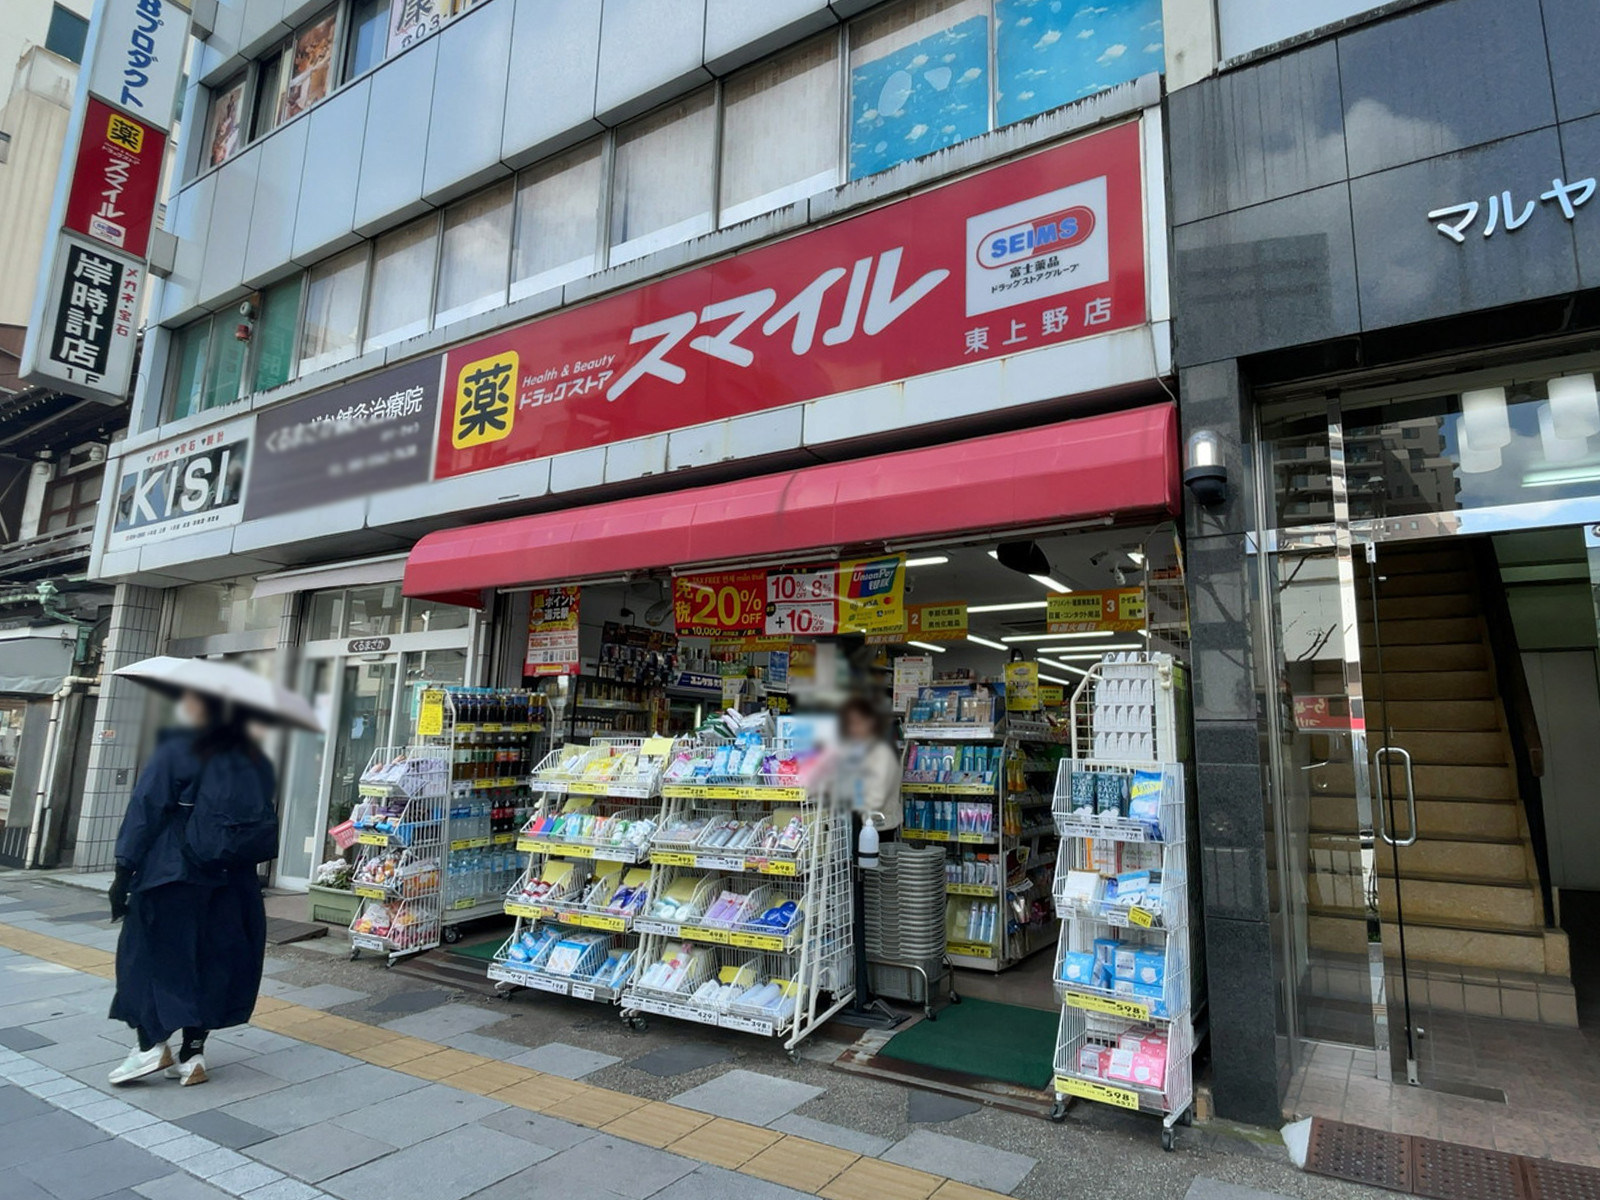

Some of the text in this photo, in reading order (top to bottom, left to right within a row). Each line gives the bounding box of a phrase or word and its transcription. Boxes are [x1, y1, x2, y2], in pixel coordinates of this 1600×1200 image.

[109, 117, 142, 150] 薬
[97, 158, 130, 218] スマイル
[991, 217, 1079, 259] SEIMS
[991, 263, 1080, 294] ドラッグストアグループ
[1010, 256, 1060, 279] 富士薬品
[59, 252, 113, 369] 岸時計店
[606, 247, 950, 402] スマイル
[964, 297, 1112, 355] 東上野店
[519, 369, 614, 410] ドラッグストア
[522, 354, 616, 388] Health & Beauty
[457, 362, 512, 441] 薬
[128, 449, 230, 526] KISI
[675, 577, 693, 623] 免税
[692, 586, 762, 626] 20%
[741, 613, 762, 624] OFF
[911, 614, 919, 625] 2
[1106, 600, 1116, 613] 3
[1116, 1003, 1141, 1015] 598
[1106, 1089, 1130, 1102] 598
